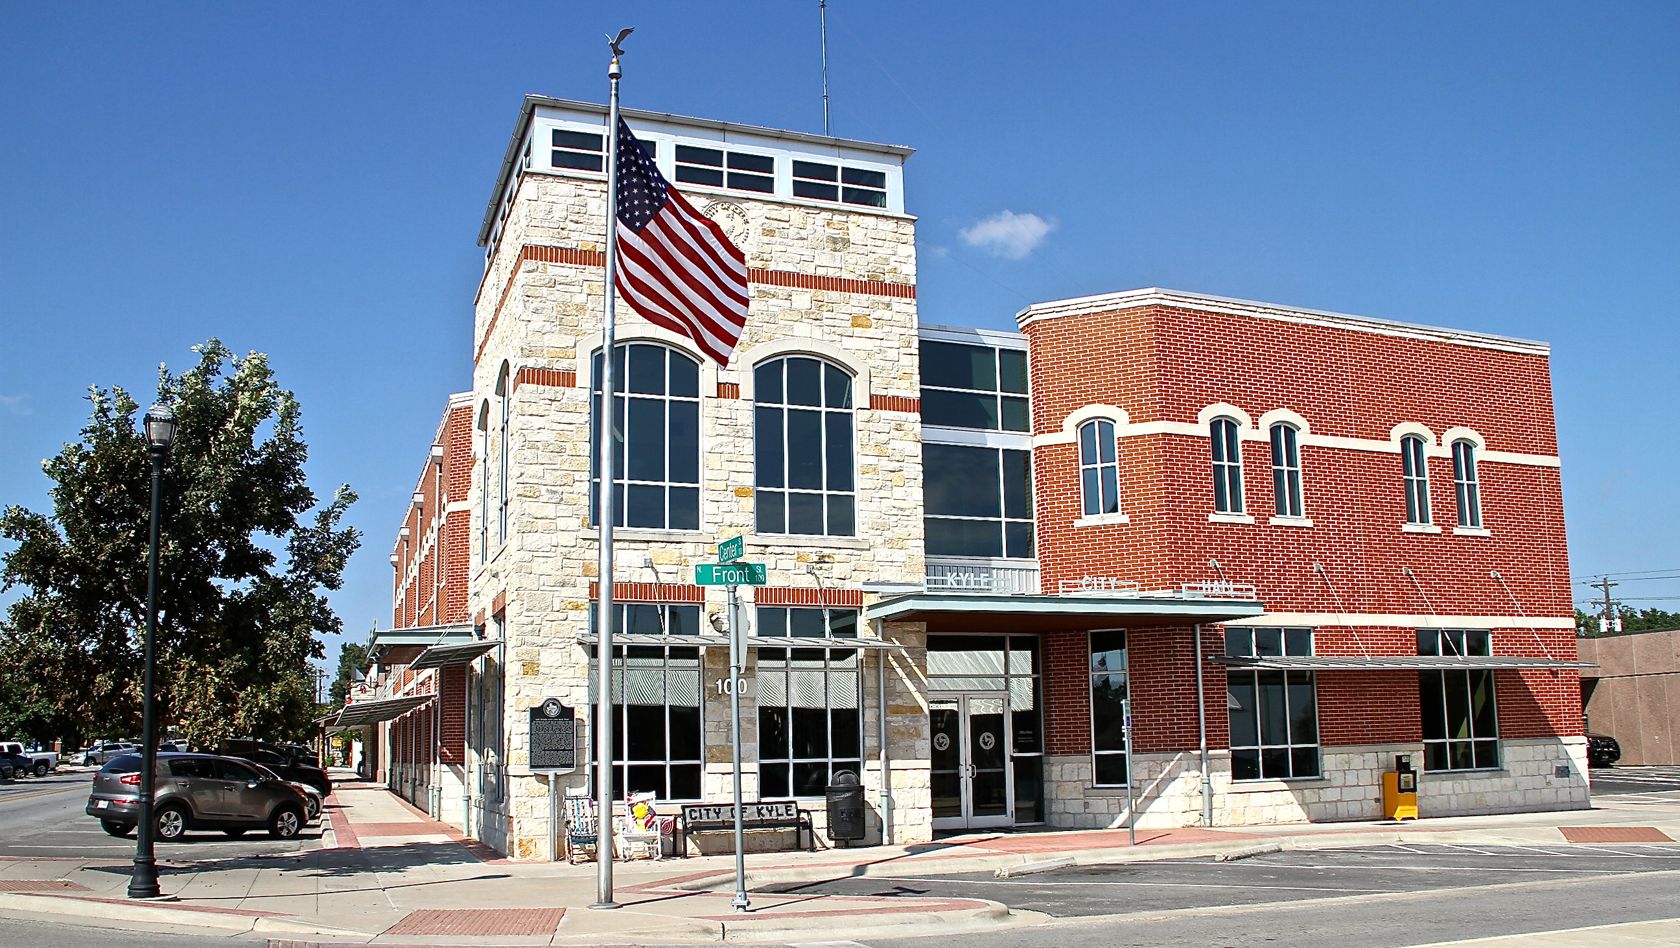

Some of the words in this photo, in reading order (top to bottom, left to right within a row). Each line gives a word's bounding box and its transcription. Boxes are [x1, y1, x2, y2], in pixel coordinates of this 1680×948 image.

[720, 542, 738, 561] Center
[712, 566, 750, 583] Front
[947, 572, 989, 588] KYLE
[1083, 575, 1118, 591] CITY
[1202, 580, 1234, 594] HALL
[715, 678, 748, 695] 100
[689, 807, 722, 820] CITY
[731, 806, 748, 818] OF
[756, 804, 793, 818] KYLE
